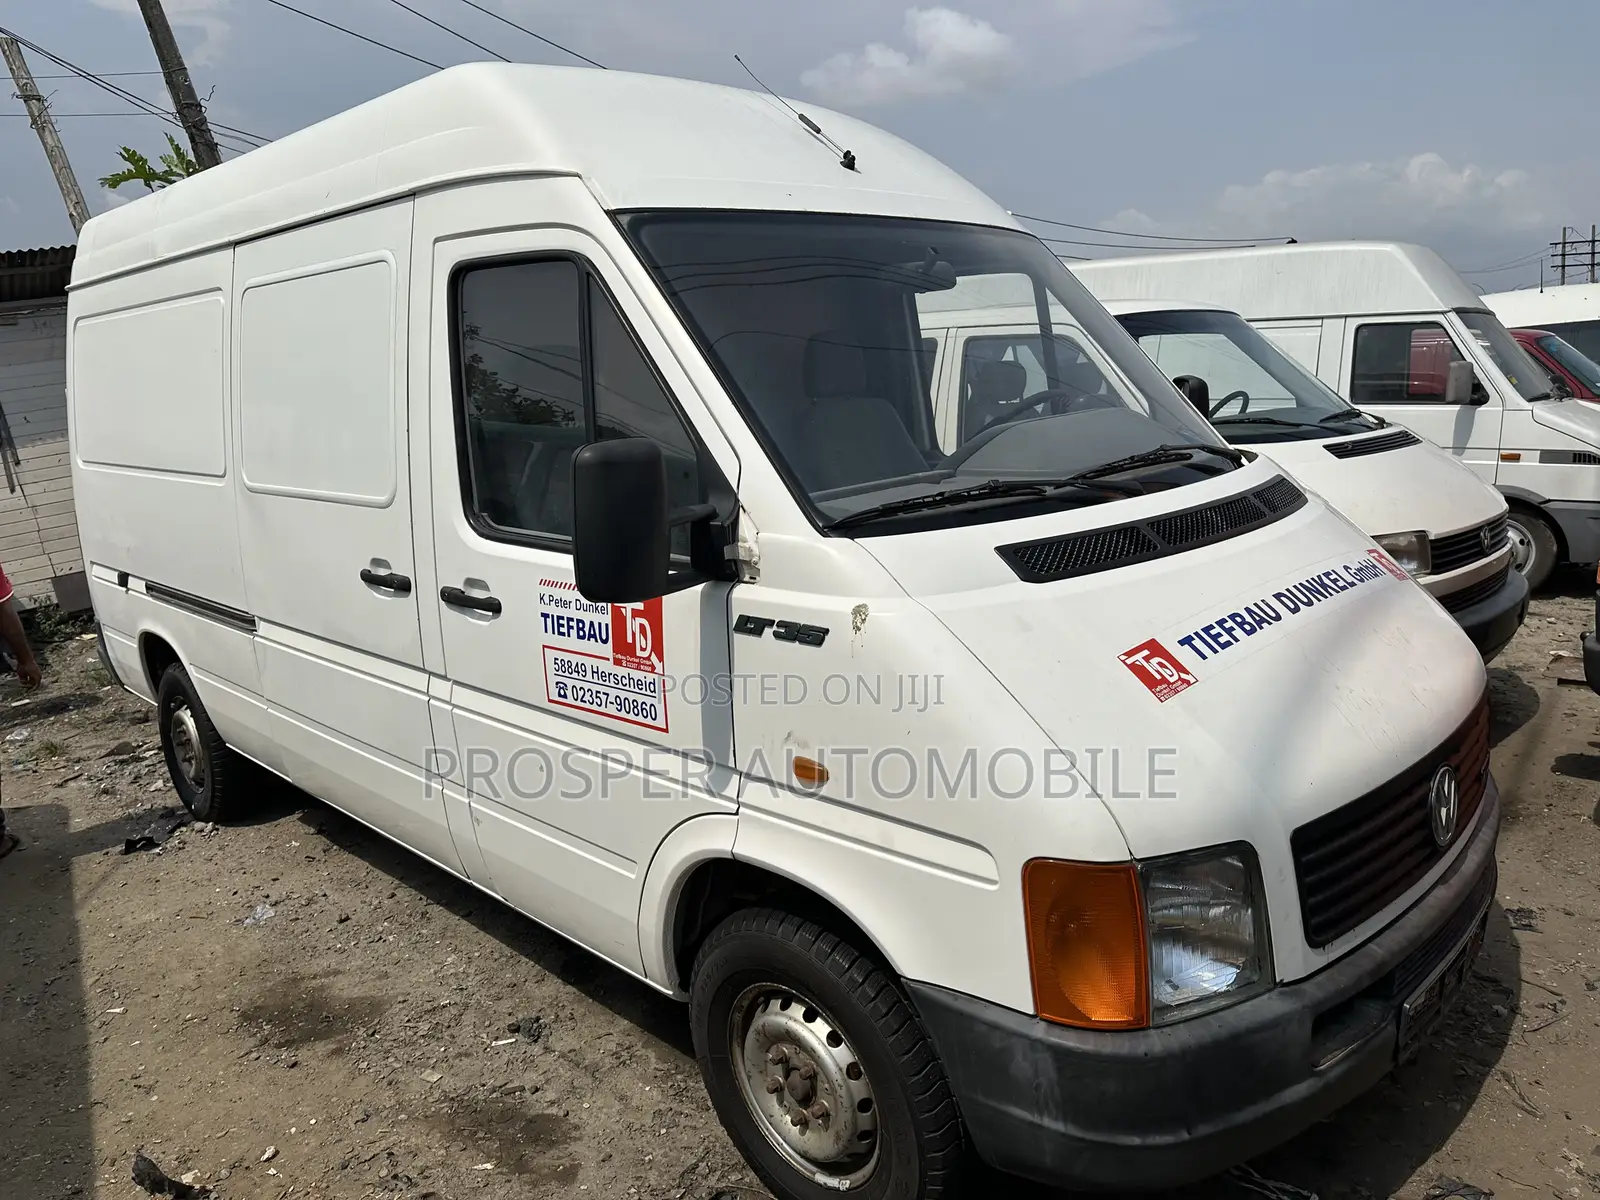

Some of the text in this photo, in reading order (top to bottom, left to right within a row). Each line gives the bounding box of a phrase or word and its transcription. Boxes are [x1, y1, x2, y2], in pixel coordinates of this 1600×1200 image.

[539, 593, 609, 615] K.Peter Dunkel
[1177, 599, 1283, 660] TIEFBAU
[1272, 569, 1356, 615] DUNKEL
[1343, 559, 1387, 583] GmbH
[540, 612, 609, 644] TIEFBAU
[553, 657, 657, 694] 58849 Herscheid
[571, 685, 658, 721] 02357-90860
